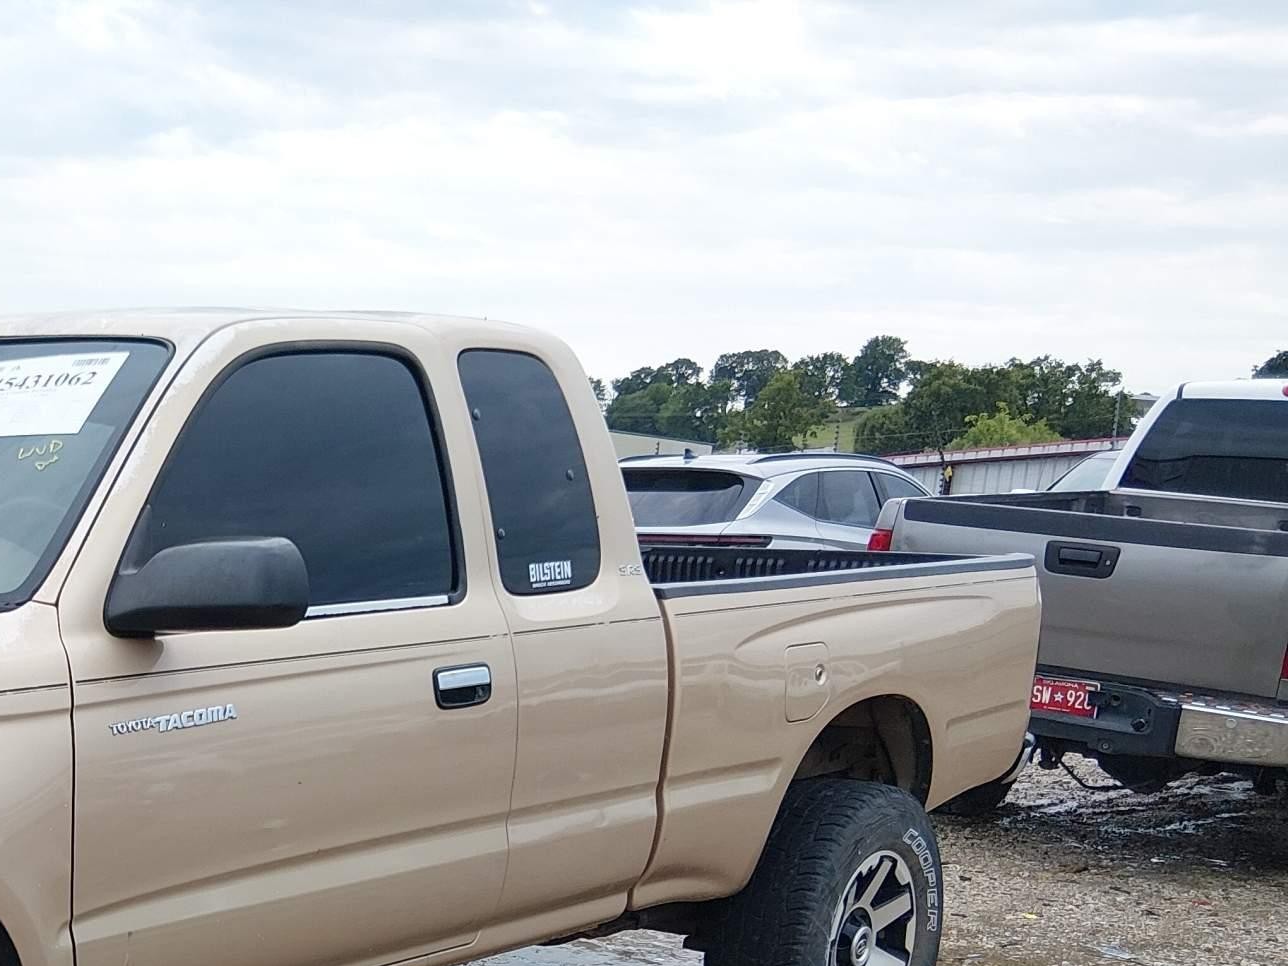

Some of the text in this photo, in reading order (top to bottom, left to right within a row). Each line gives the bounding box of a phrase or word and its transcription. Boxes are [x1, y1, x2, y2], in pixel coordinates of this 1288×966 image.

[529, 560, 572, 582] BILSTEIN
[109, 703, 237, 735] TOYOTA TACOMA
[902, 828, 939, 932] COOPER
